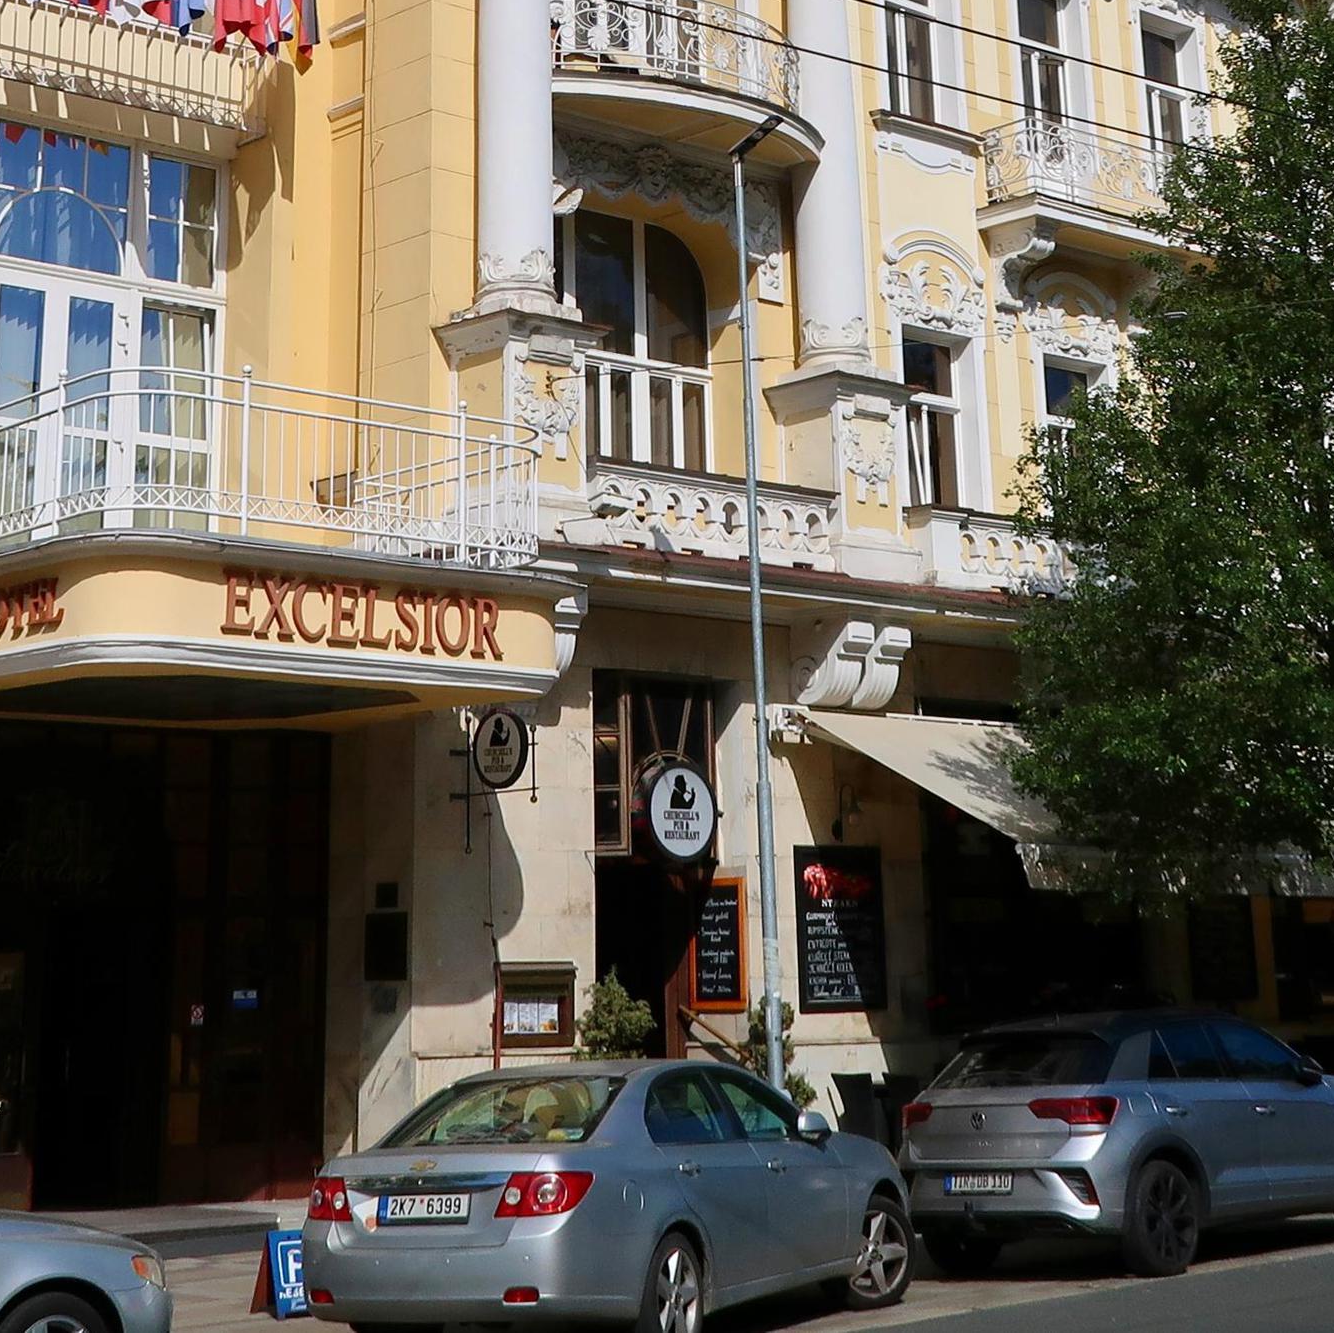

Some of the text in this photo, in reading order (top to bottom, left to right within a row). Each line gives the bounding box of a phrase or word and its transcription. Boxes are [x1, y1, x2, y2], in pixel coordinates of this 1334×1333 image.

[220, 569, 504, 661] EXCELSIOR
[673, 820, 684, 831] PUB
[664, 830, 700, 841] RESTAURANT
[391, 1197, 461, 1216] 2K7 6399
